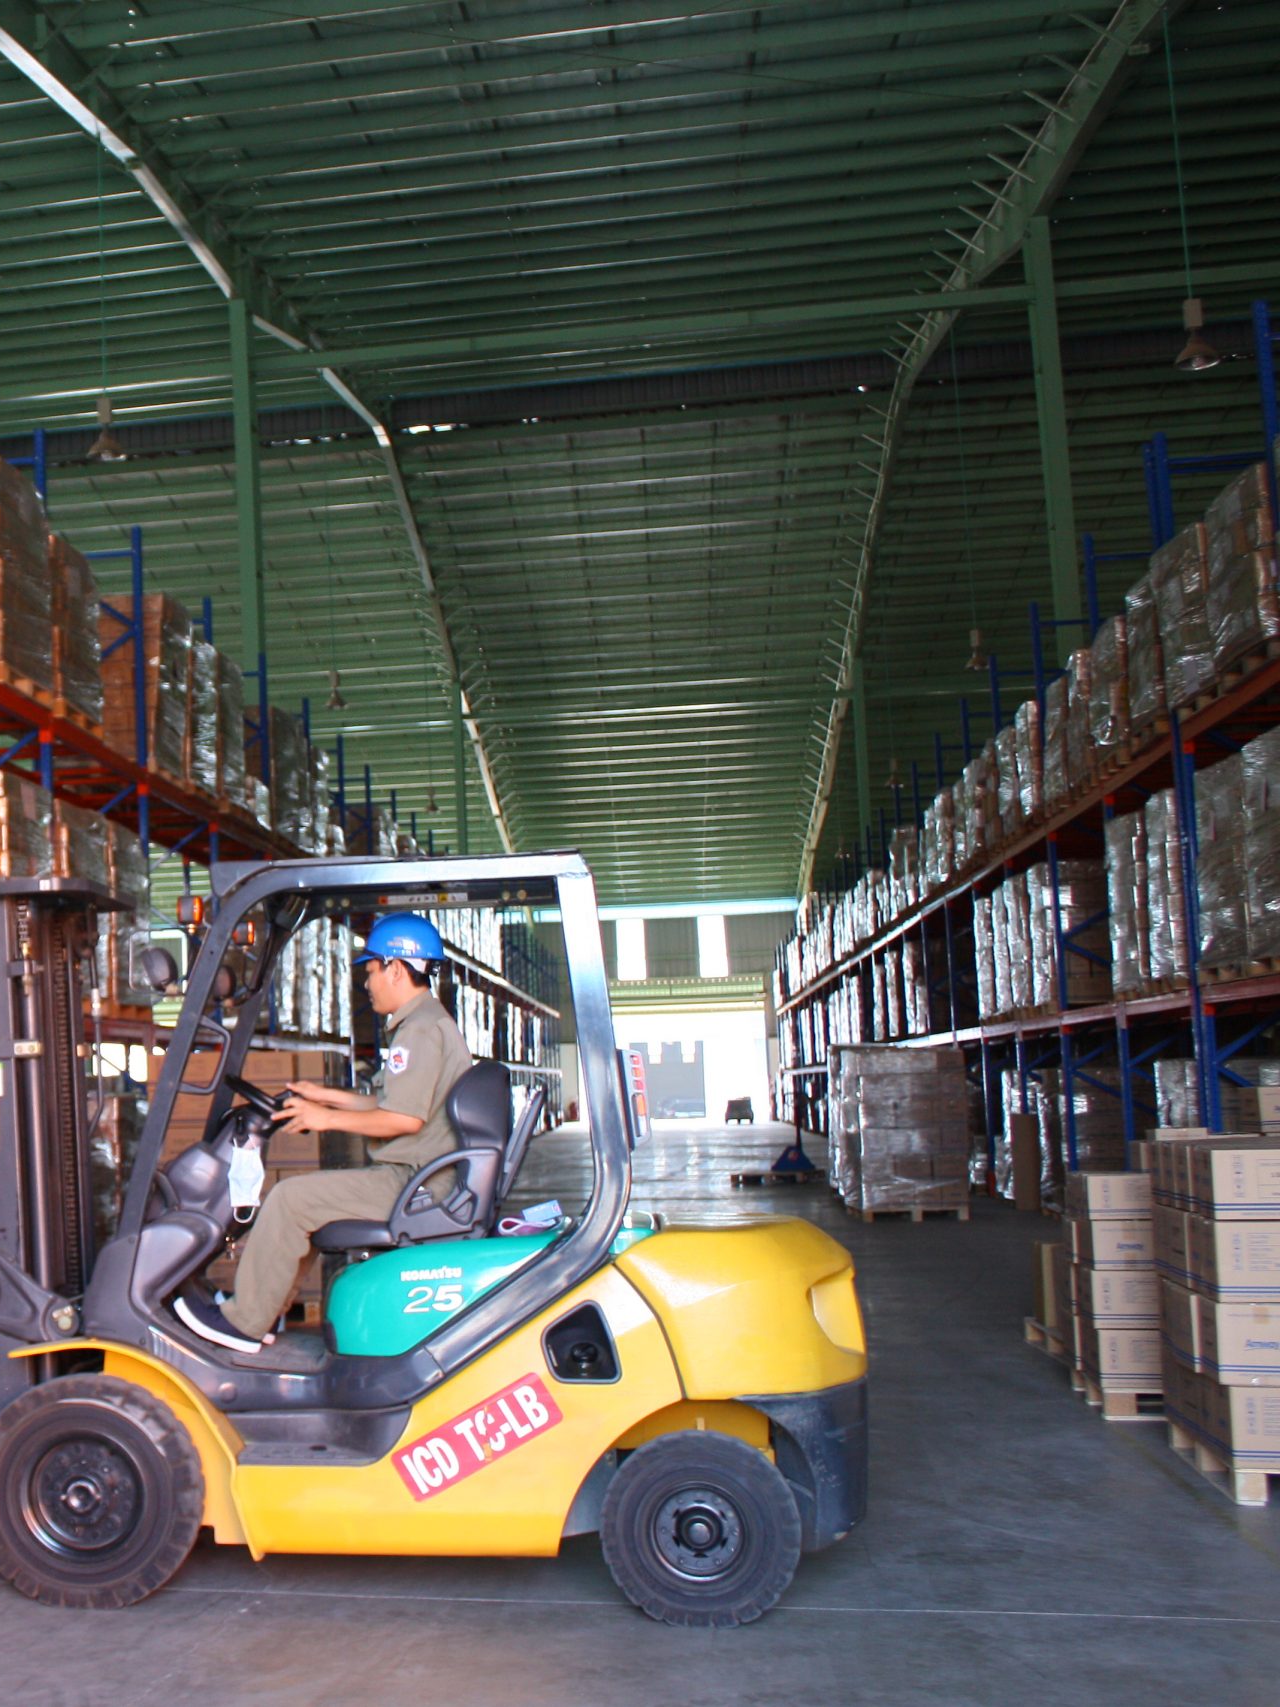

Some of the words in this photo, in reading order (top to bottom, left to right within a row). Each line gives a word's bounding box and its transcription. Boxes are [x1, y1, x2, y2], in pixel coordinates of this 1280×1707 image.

[400, 1266, 462, 1281] KOMATSU
[403, 1284, 464, 1314] 25
[401, 1437, 460, 1494] ICD
